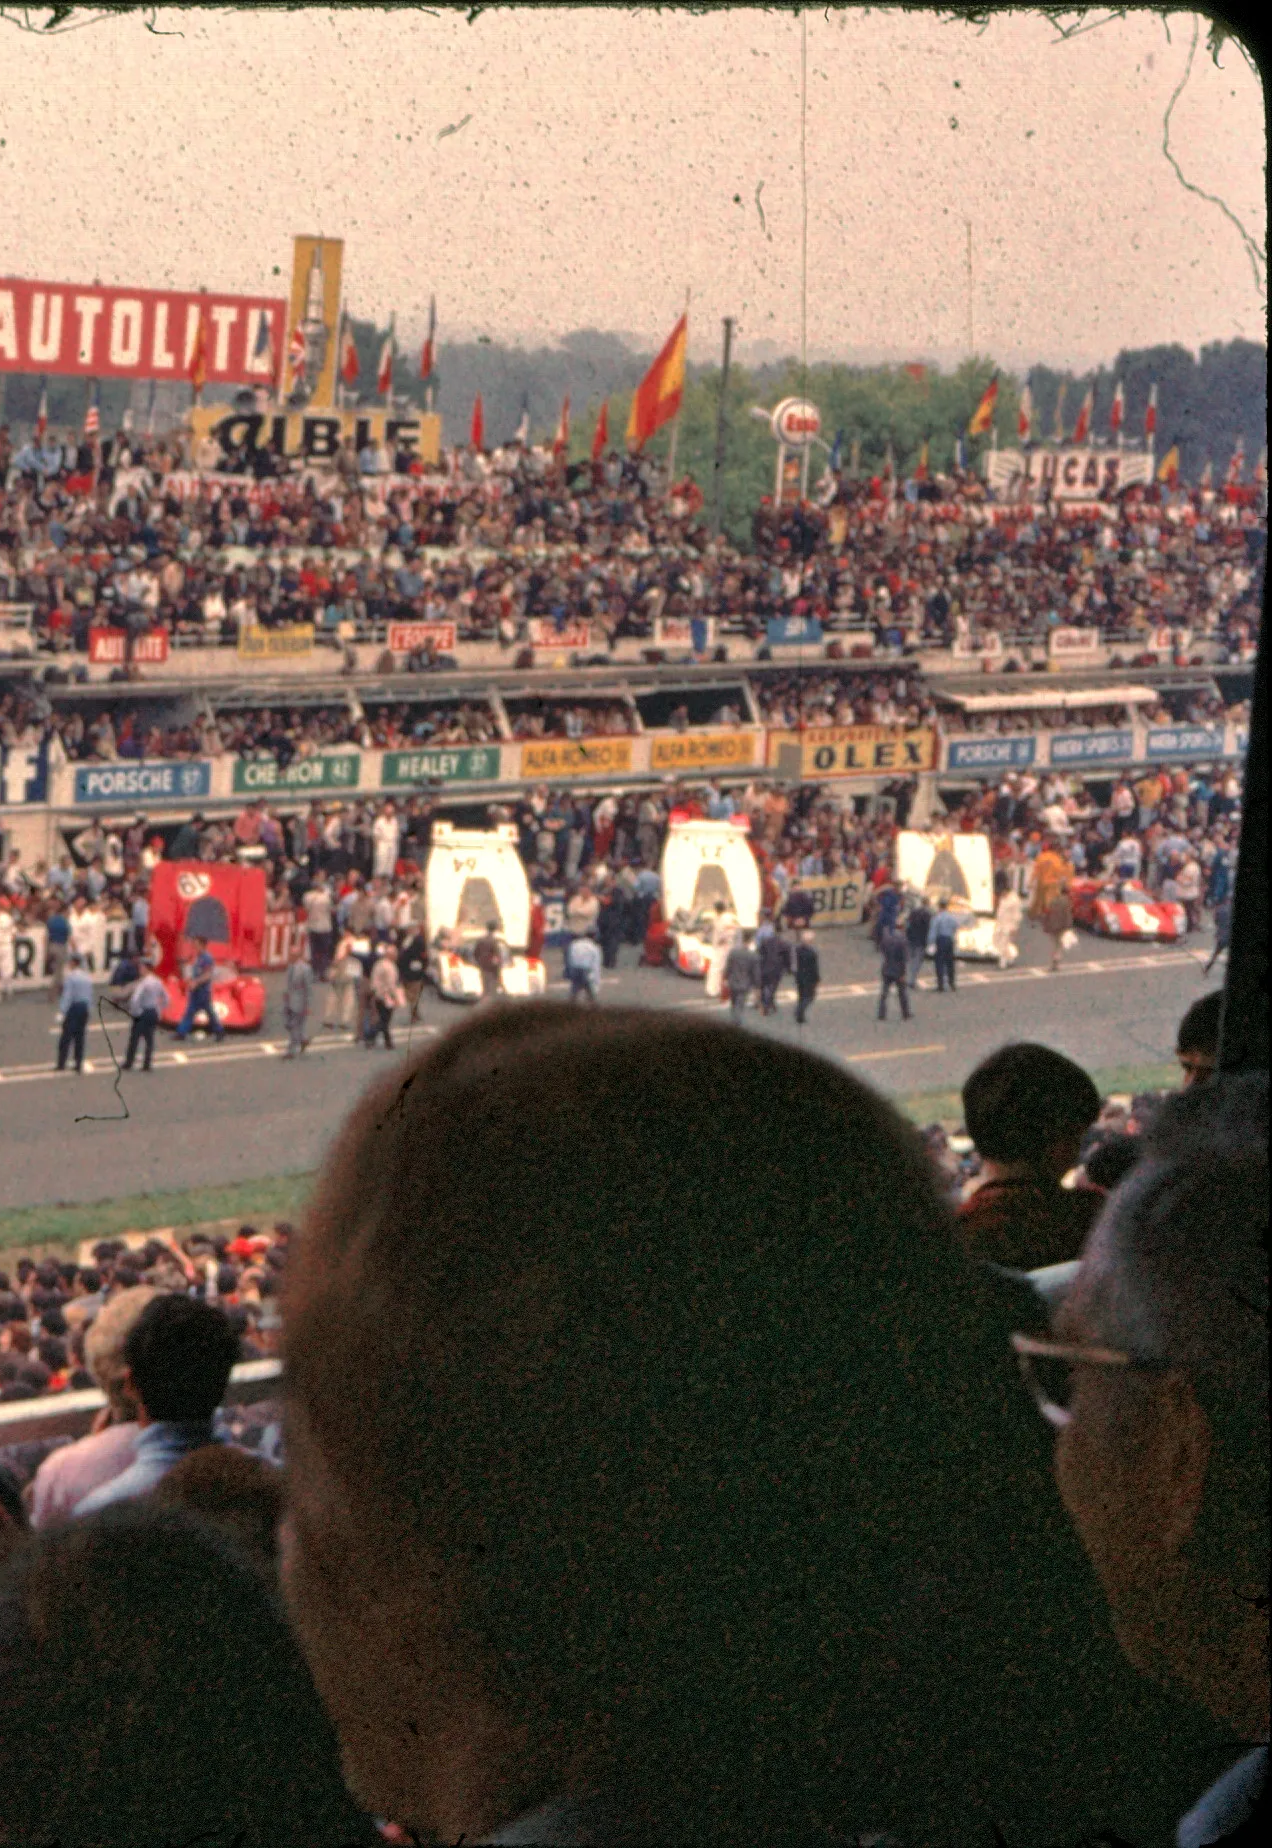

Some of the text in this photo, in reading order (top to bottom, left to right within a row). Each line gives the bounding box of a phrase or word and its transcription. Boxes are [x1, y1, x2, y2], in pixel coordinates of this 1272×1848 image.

[95, 633, 163, 660] AUTLITE
[397, 754, 460, 777] HEALEY
[814, 741, 921, 770] OLEX
[87, 768, 173, 795] PORSCHE
[244, 761, 325, 786] CHERON
